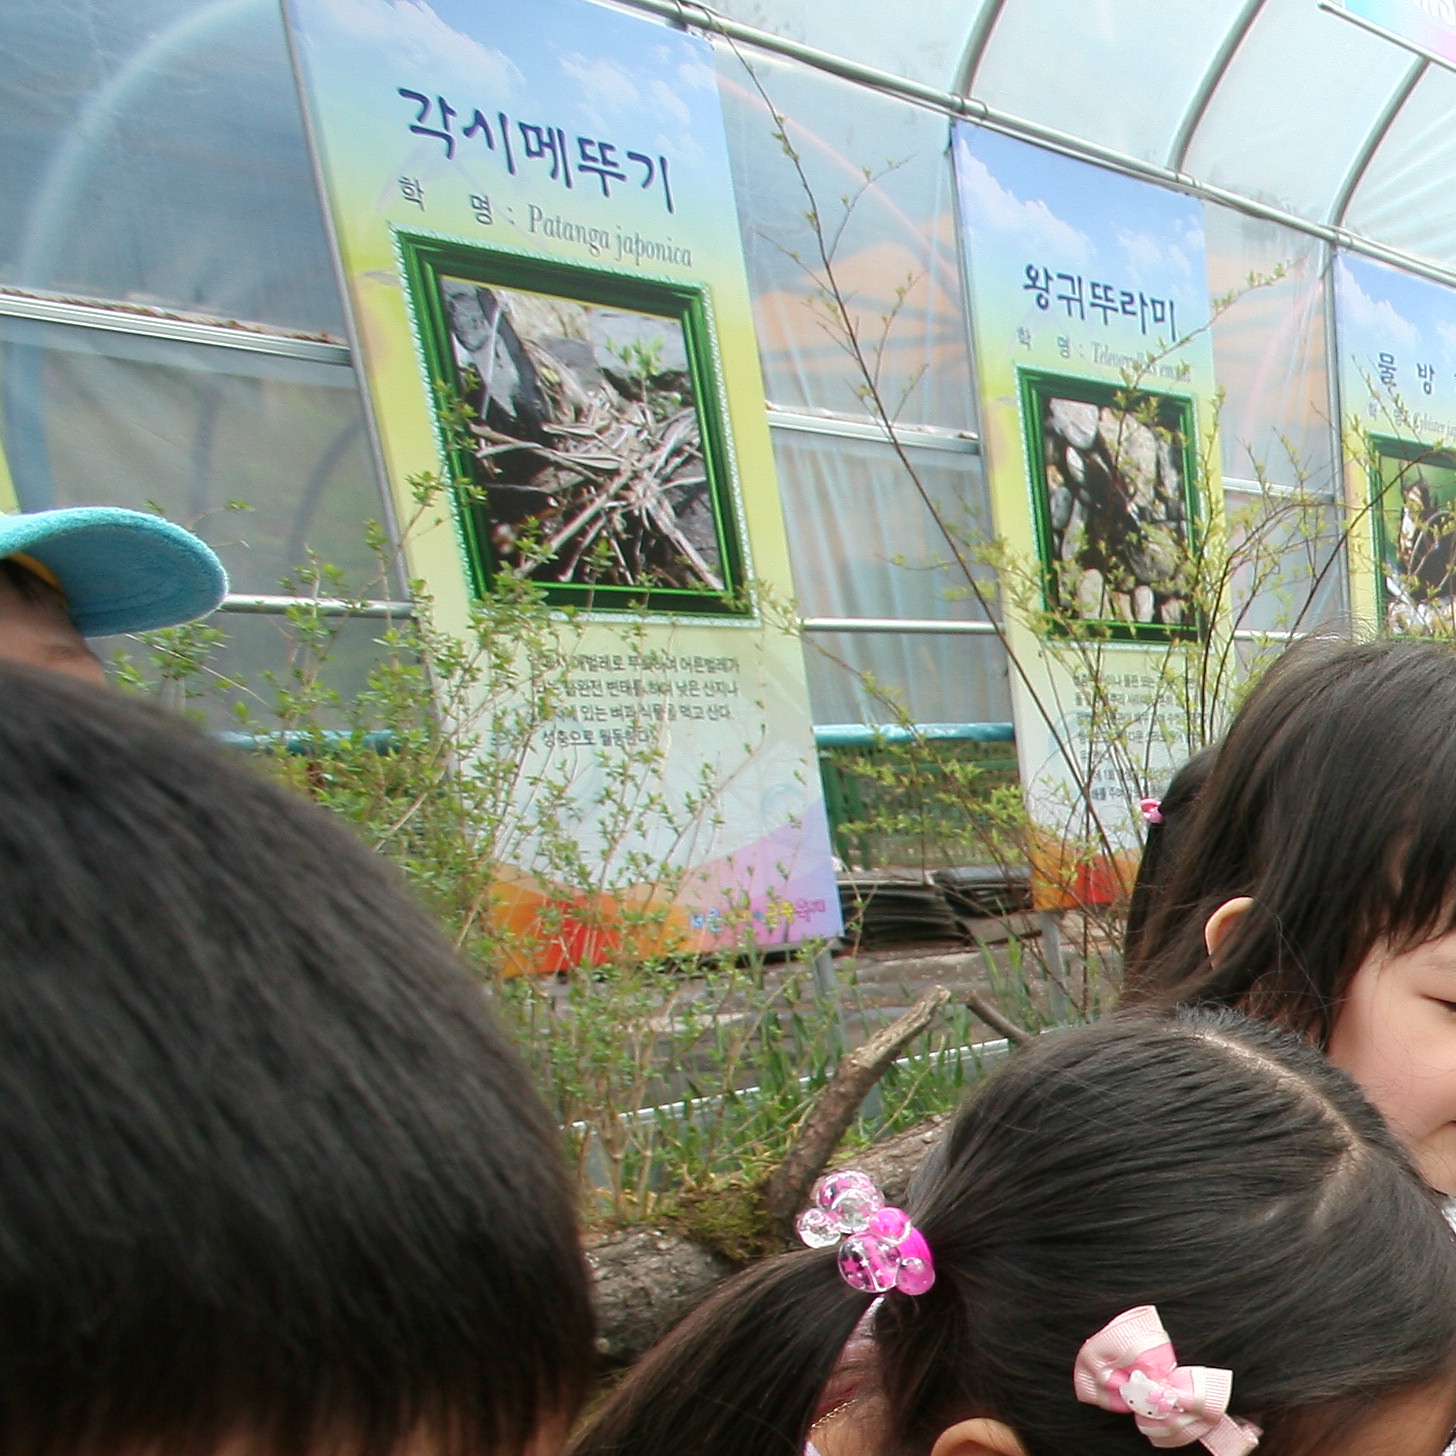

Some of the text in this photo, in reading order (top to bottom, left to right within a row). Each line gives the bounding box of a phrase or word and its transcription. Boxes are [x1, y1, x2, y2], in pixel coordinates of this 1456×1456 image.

[398, 86, 675, 215] 각시메뚜기
[398, 176, 693, 268] 학 명 Patanga japonica
[1022, 263, 1177, 342] 왕귀뚜라미
